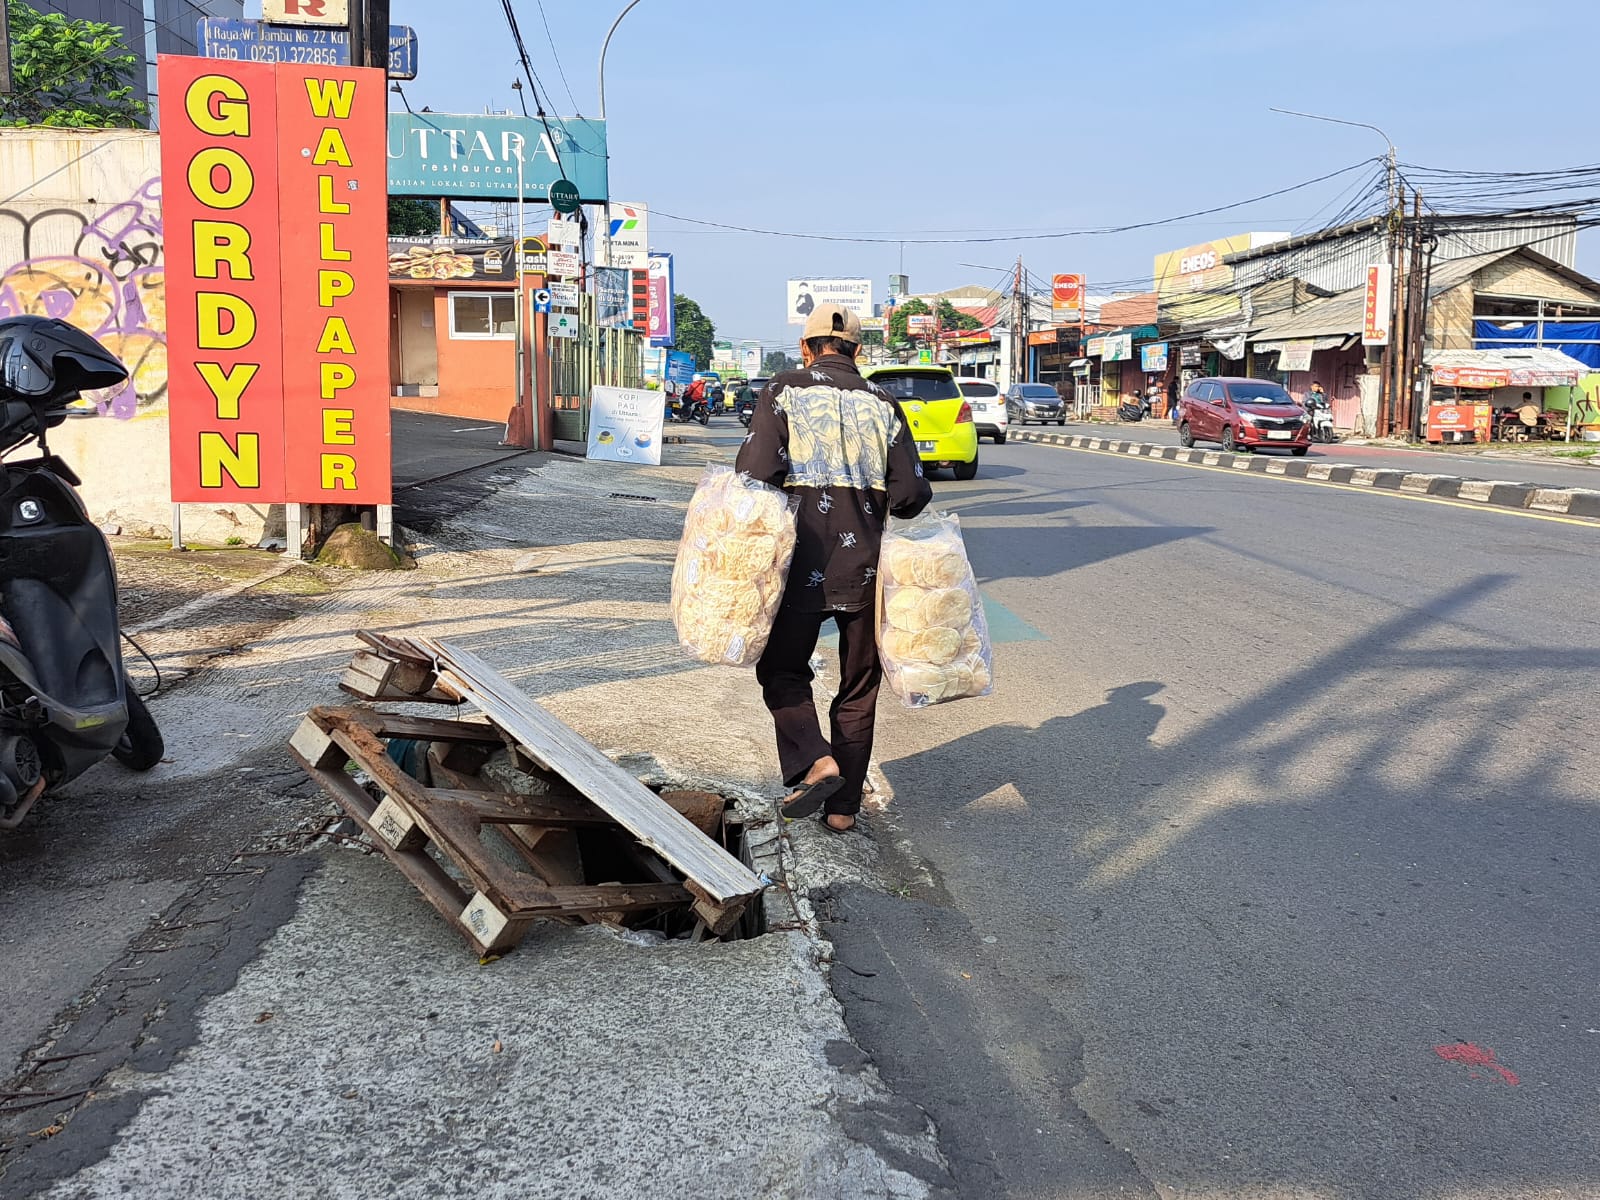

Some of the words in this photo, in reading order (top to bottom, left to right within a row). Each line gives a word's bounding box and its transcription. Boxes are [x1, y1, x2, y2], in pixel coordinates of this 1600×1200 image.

[259, 28, 293, 42] Jambu
[313, 30, 327, 44] 22
[290, 45, 337, 66] 372856
[387, 127, 560, 164] UTTARA
[421, 162, 522, 174] restauran
[431, 180, 464, 188] LOKAL
[469, 181, 482, 189] DI
[1181, 250, 1216, 274] ENEOS
[184, 74, 261, 489] GORDYN
[304, 77, 358, 491] WALLPAPER
[1365, 268, 1376, 331] PLAVON
[618, 393, 639, 401] KOPI
